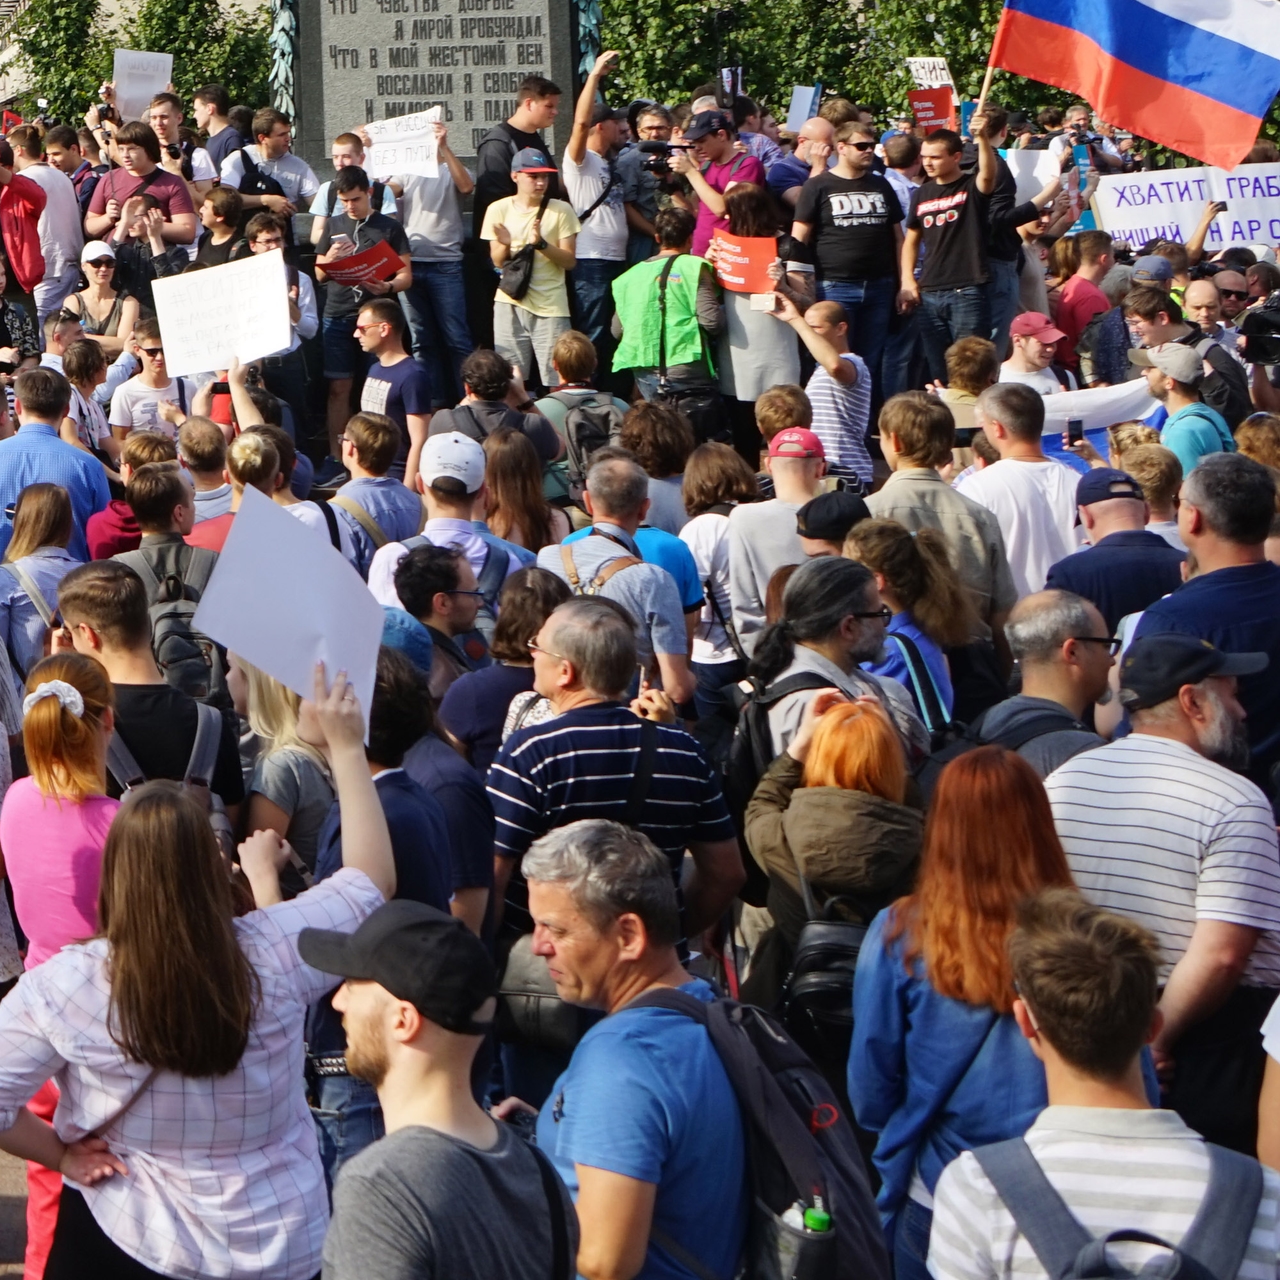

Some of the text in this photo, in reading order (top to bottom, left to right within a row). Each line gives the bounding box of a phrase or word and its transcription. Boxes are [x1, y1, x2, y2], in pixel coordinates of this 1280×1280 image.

[395, 20, 404, 41] Я
[411, 15, 453, 40] ЛИРОЙ
[369, 46, 378, 68] В
[389, 43, 418, 67] МОЙ
[429, 41, 506, 66] ЖЕСТОКИЙ
[517, 44, 543, 65] ВЕК
[377, 72, 543, 96] ВОССЛАВИЛ Я СВОБ
[366, 99, 373, 123] И
[374, 148, 397, 166] БЕЗ
[1112, 175, 1280, 208] ХВАТИТ ГРАБ
